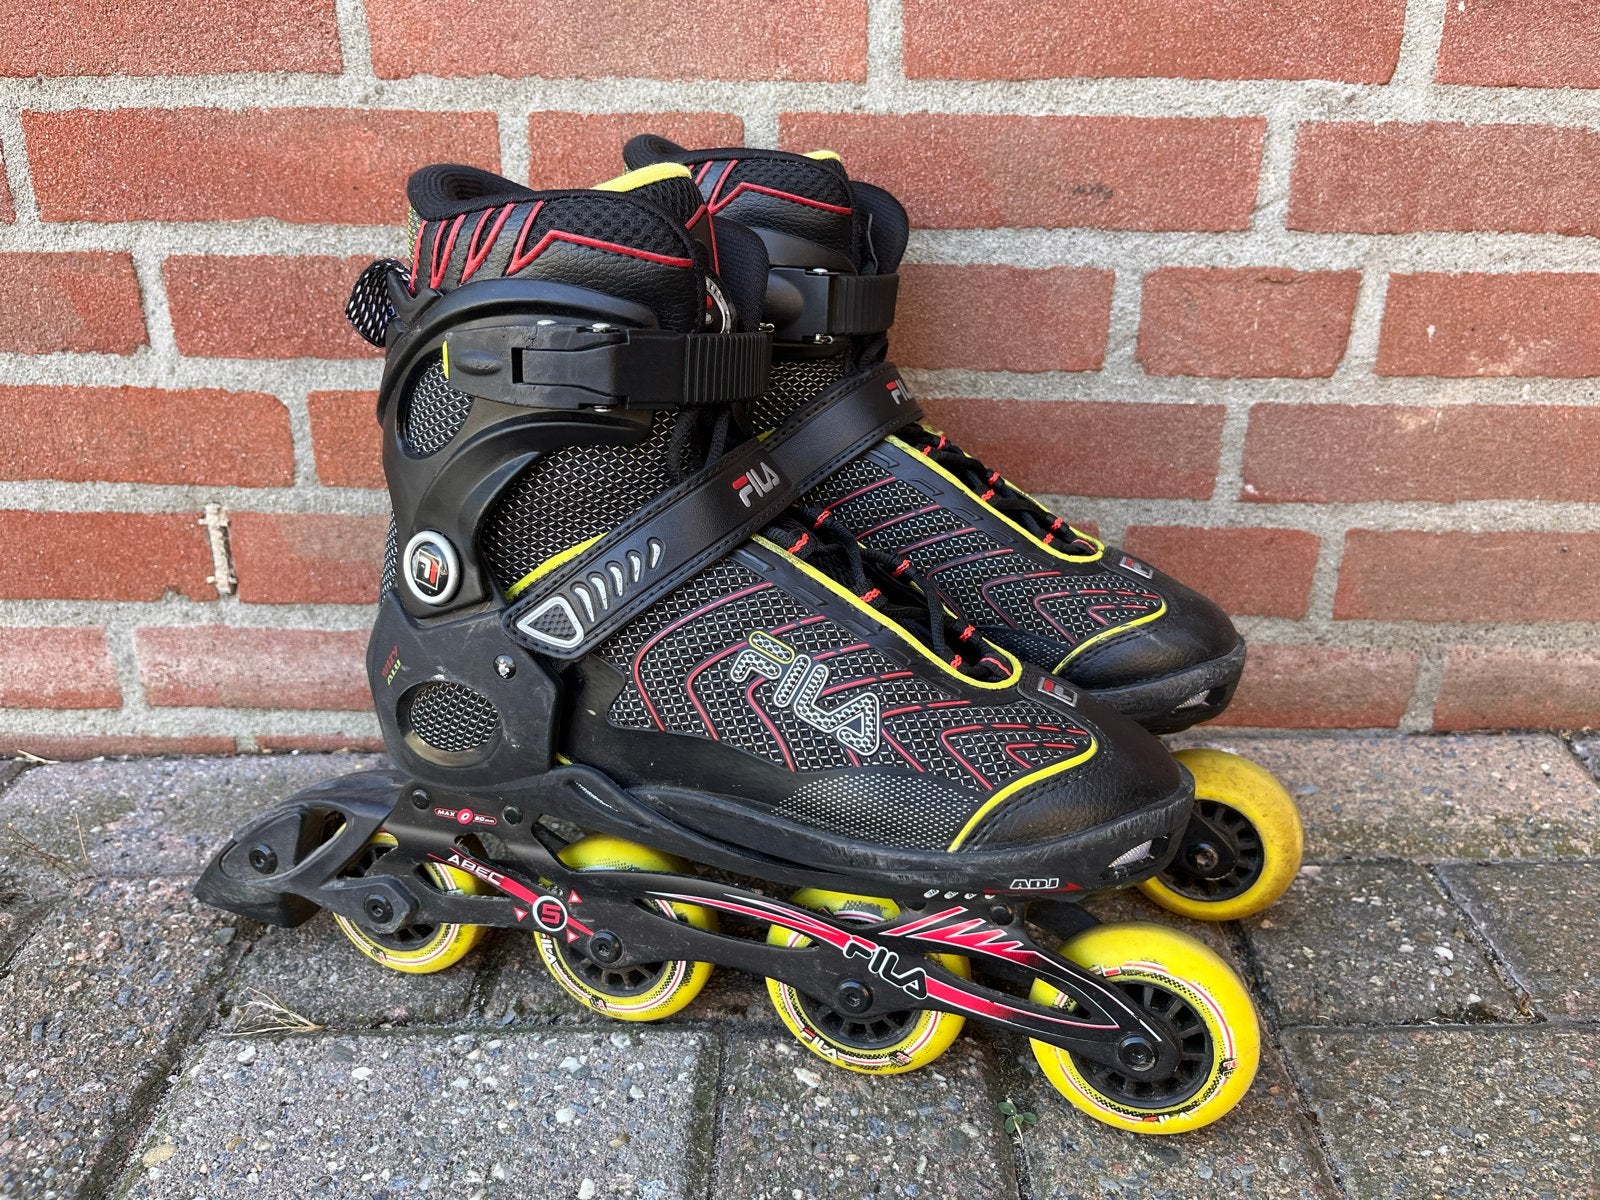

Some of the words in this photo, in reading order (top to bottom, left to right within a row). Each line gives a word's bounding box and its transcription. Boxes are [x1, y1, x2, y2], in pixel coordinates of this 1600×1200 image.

[885, 378, 913, 405] FIL
[732, 461, 780, 508] FILA
[730, 630, 880, 756] FILA
[437, 809, 457, 817] MAX
[447, 854, 505, 886] ABEC
[1009, 877, 1060, 890] ADJ
[843, 934, 929, 1000] FILA
[800, 1027, 838, 1060] FILA
